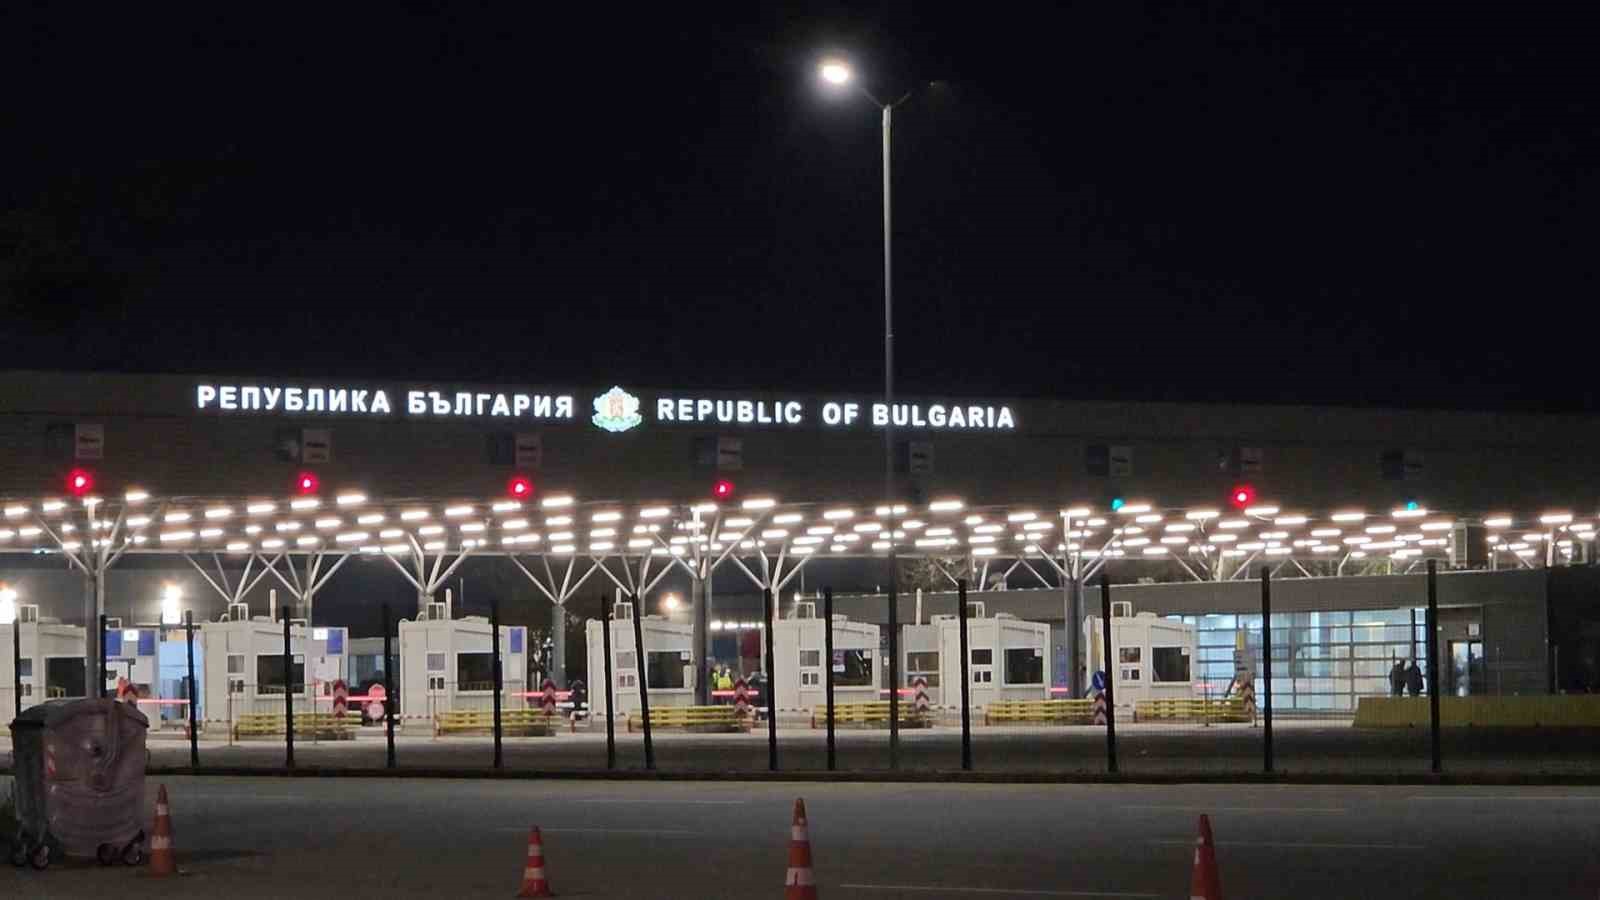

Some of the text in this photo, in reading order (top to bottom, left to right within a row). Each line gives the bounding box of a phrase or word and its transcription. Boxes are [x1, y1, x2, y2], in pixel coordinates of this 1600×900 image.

[196, 384, 574, 419] РЕПУБЛИКА БЪЛГАРИЯ
[657, 397, 1015, 429] REPUBLIC OF BULGARIA
